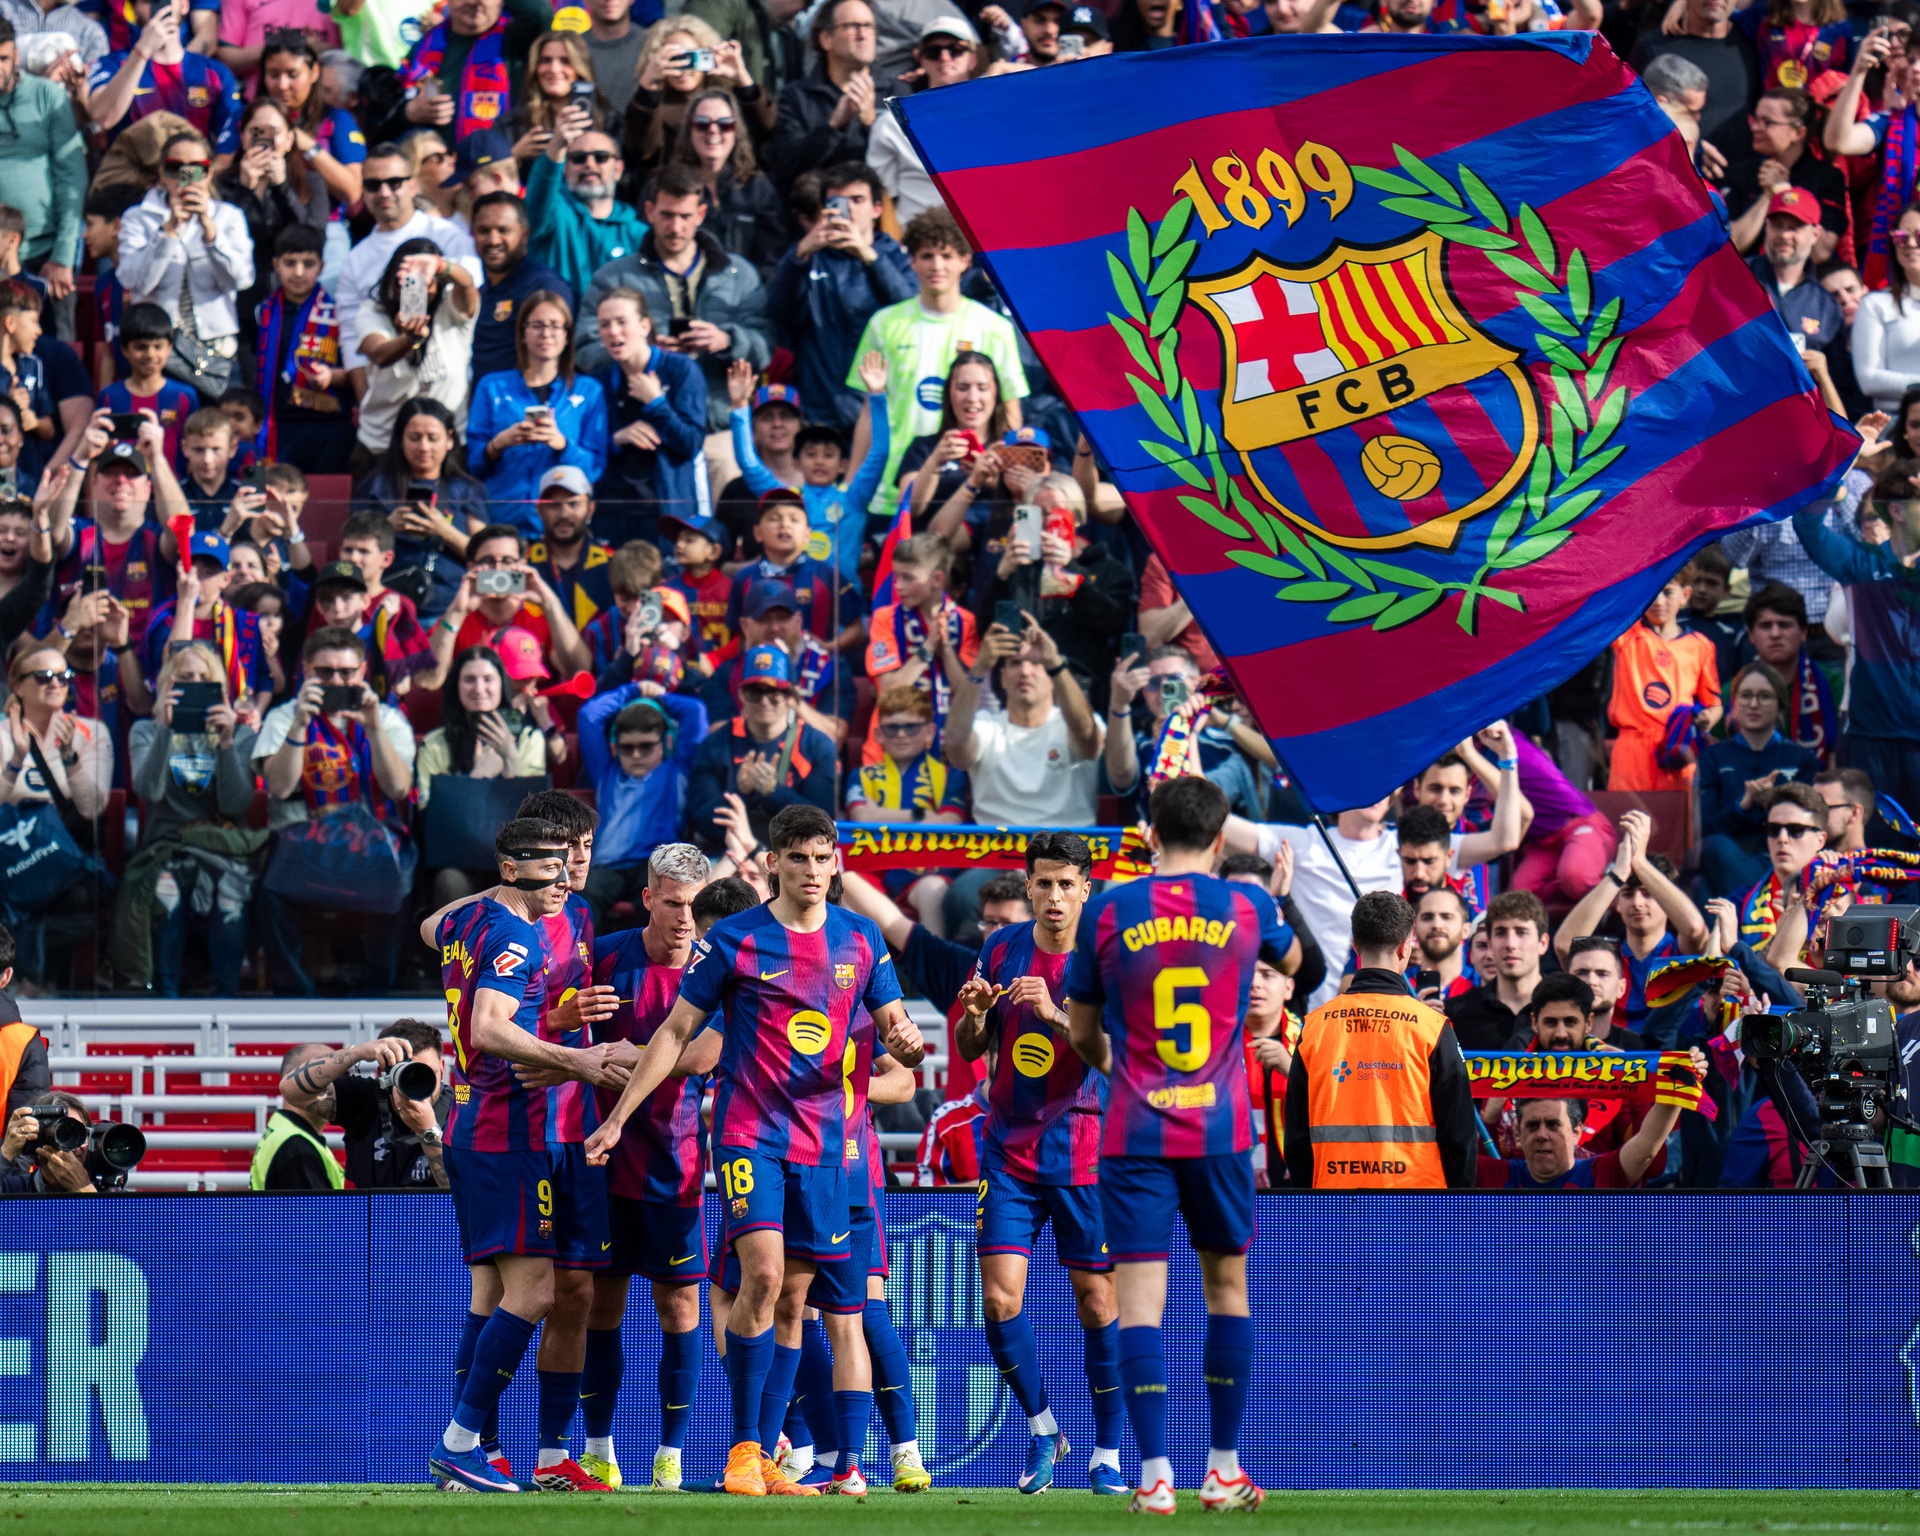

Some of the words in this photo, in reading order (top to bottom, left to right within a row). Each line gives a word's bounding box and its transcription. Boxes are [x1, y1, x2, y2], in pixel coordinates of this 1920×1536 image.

[1173, 140, 1353, 239] 1899
[848, 826, 1110, 860] Almogàs
[1123, 916, 1237, 952] CUBARSÍ
[1153, 966, 1211, 1072] 5
[1466, 1053, 1649, 1090] ogàvers
[721, 1158, 754, 1200] 18
[1327, 1160, 1407, 1175] STEWARD
[538, 1180, 553, 1216] 9
